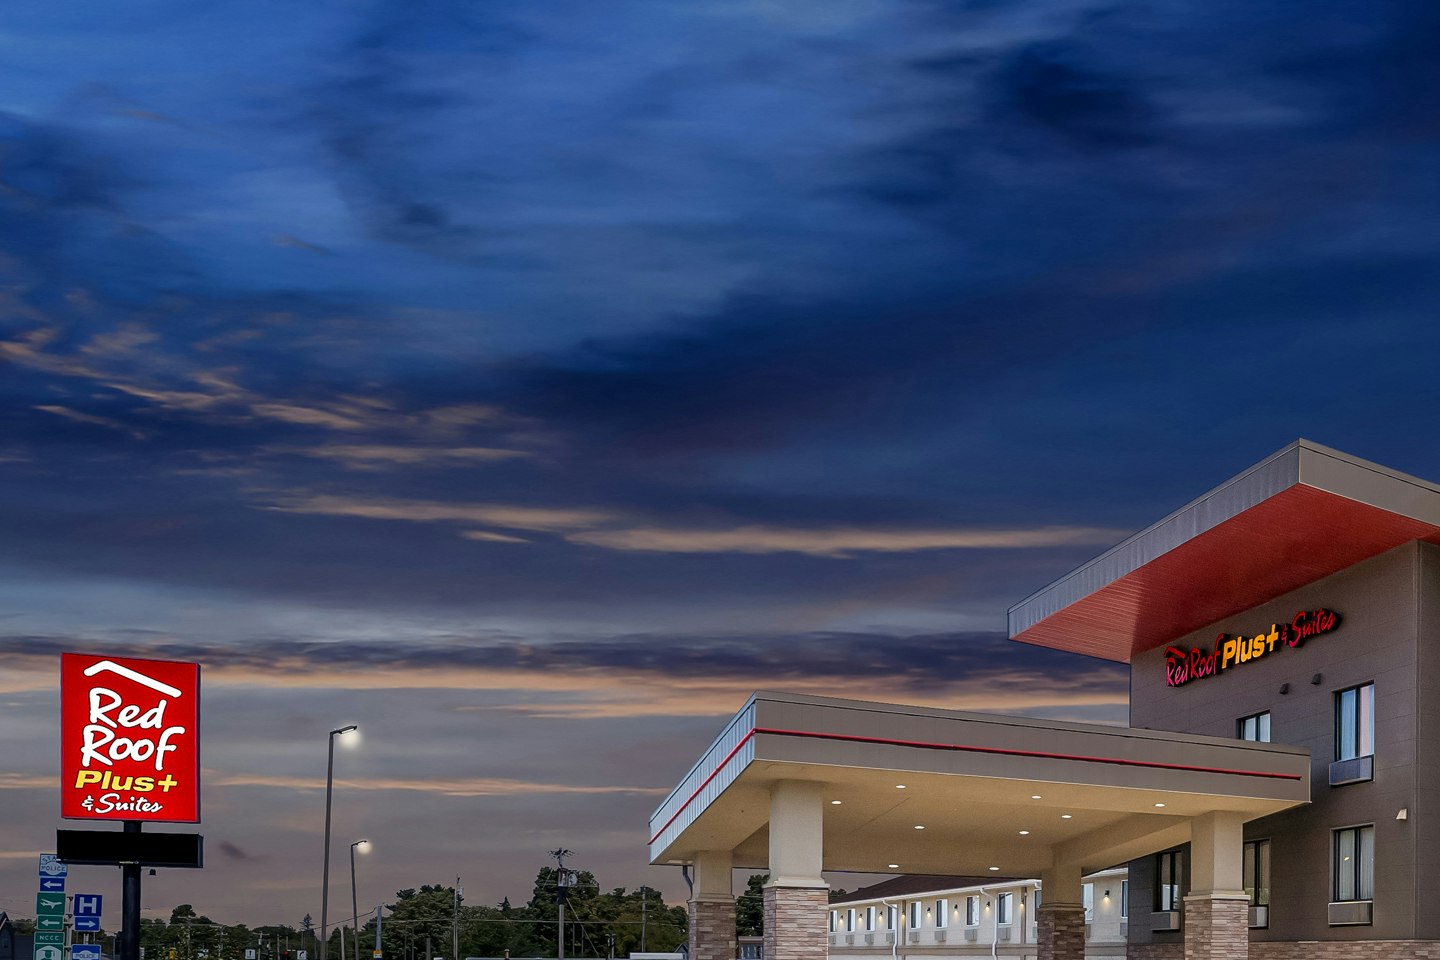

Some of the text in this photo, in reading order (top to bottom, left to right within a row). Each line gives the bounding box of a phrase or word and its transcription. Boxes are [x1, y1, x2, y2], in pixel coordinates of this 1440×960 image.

[1166, 656, 1189, 687] Red
[1190, 633, 1224, 679] Roof
[1221, 623, 1279, 669] Plus+
[1288, 607, 1336, 648] Suites
[89, 686, 167, 729] Red
[80, 724, 186, 771] Roof
[74, 769, 178, 792] Plus+
[81, 792, 163, 814] & Suites
[79, 896, 97, 914] H
